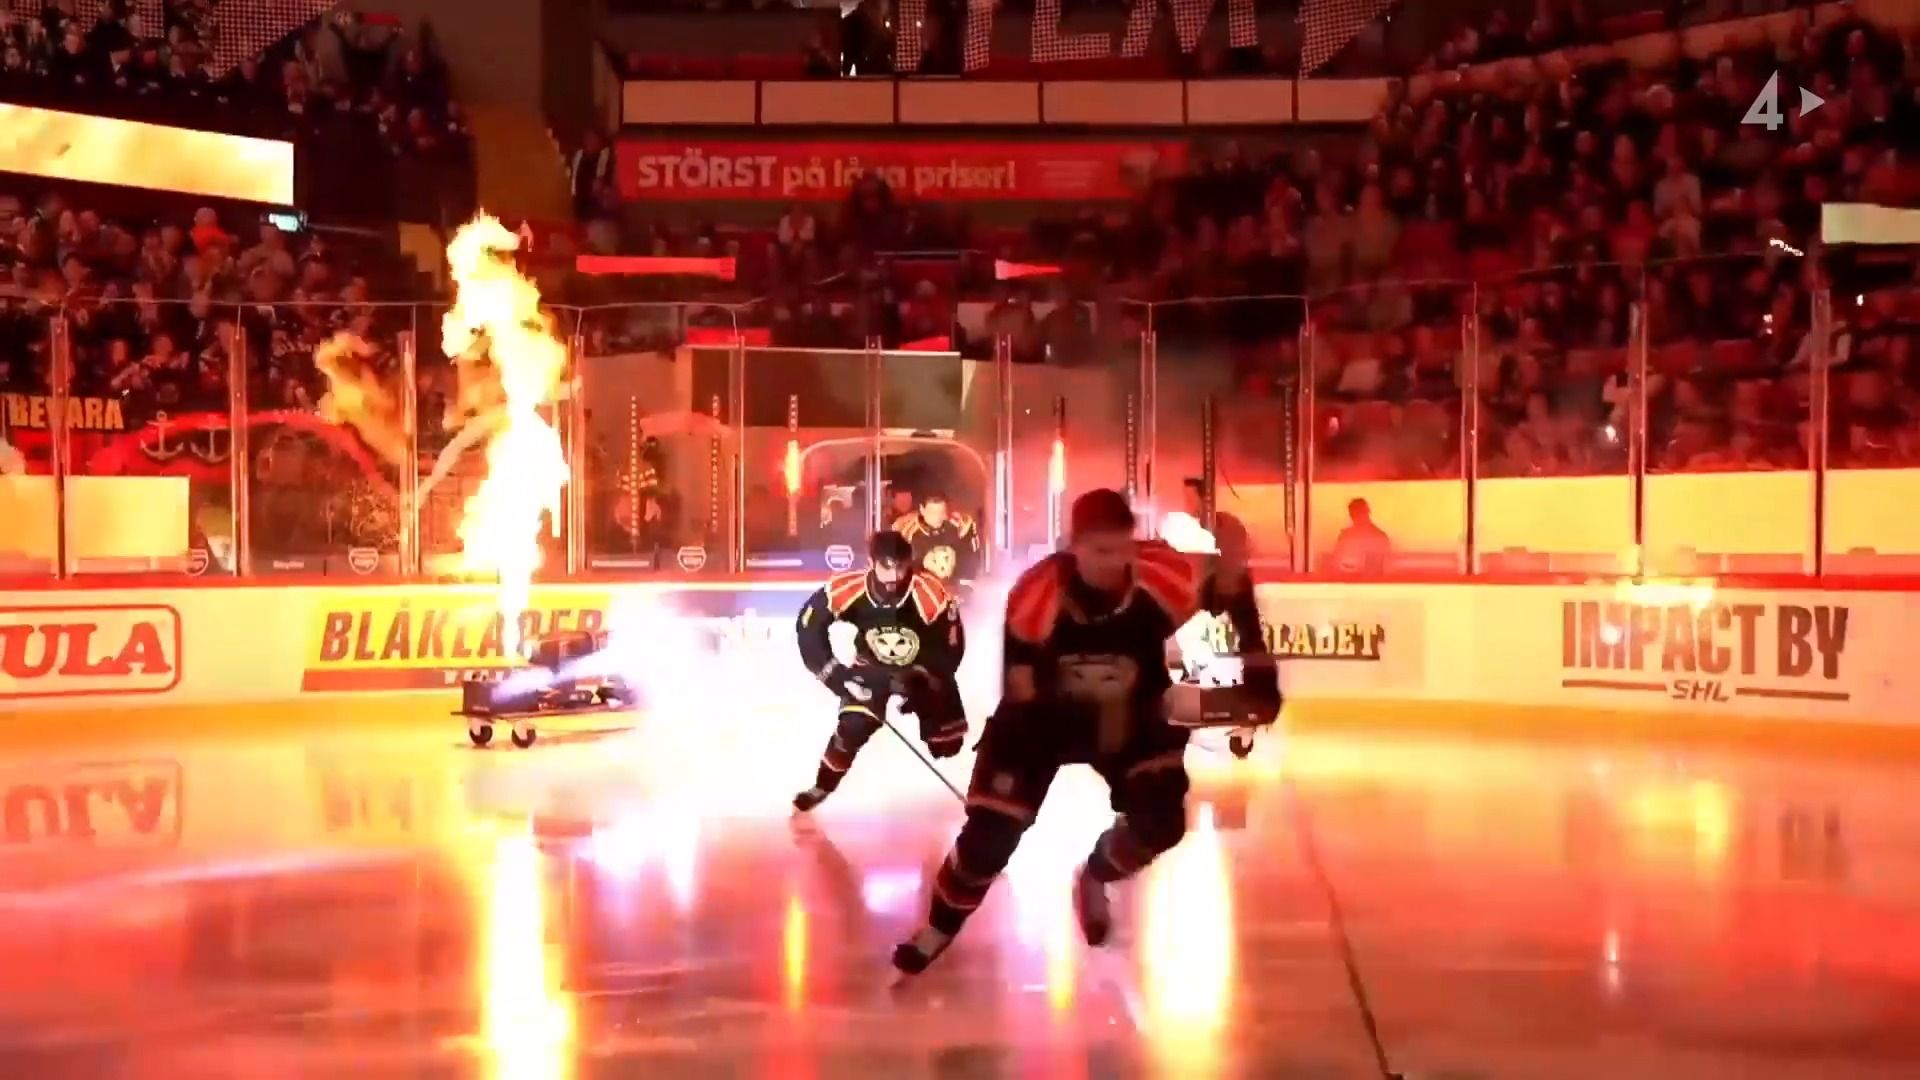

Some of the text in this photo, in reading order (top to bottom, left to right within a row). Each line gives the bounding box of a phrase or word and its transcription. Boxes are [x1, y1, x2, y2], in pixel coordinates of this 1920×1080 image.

[638, 147, 777, 188] STÖRST
[783, 157, 826, 196] på
[833, 156, 907, 188] låa
[915, 159, 1016, 195] priser!
[8, 395, 125, 430] BEARA
[1563, 601, 1848, 680] IMPACT BY
[1672, 680, 1729, 702] SHL
